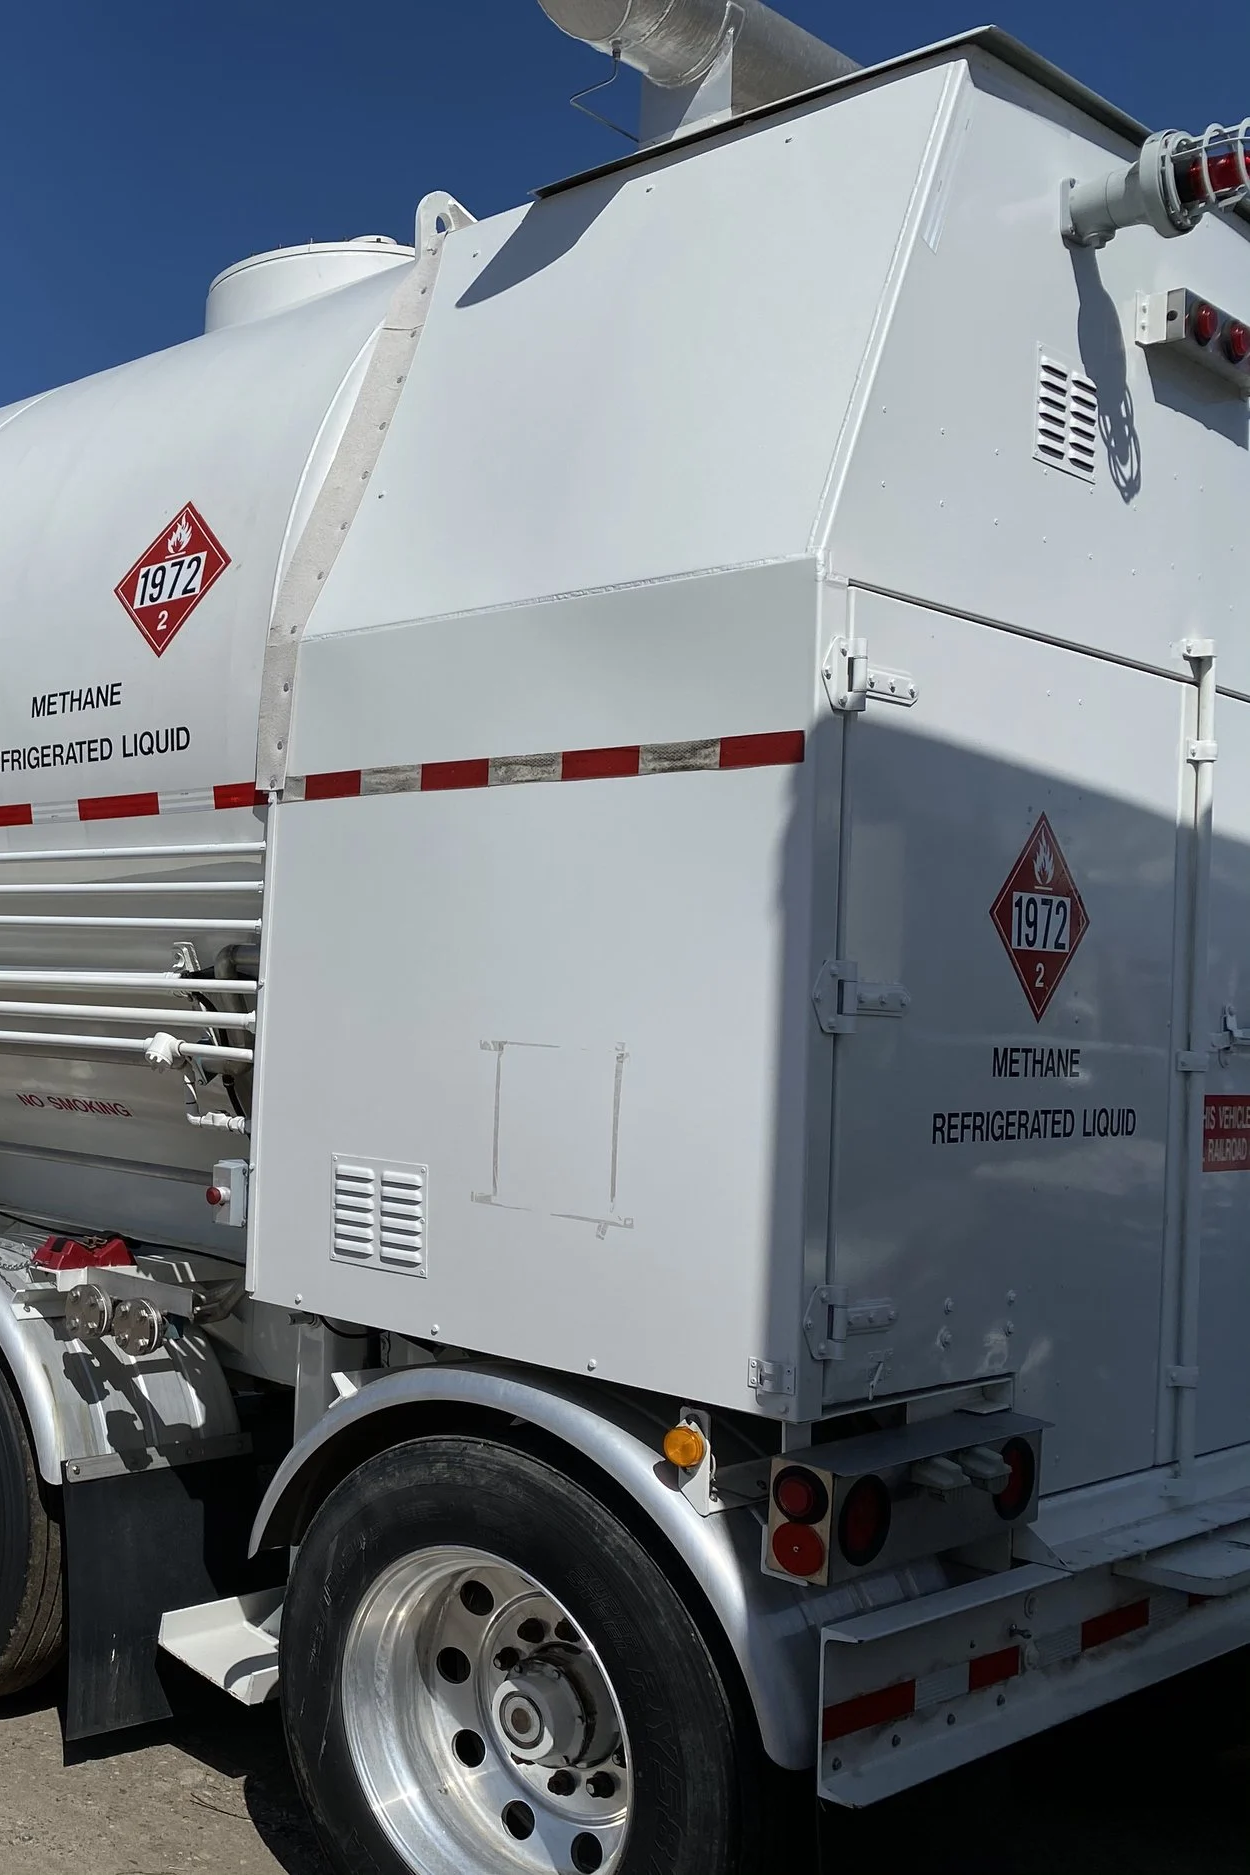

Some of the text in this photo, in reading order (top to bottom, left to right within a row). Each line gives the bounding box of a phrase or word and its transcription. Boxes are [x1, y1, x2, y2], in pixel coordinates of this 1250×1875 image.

[139, 555, 202, 606] 1972
[156, 610, 169, 631] 2
[31, 682, 122, 718] METHANE
[122, 726, 191, 758] LIQUID
[1014, 895, 1068, 950] 1972
[1035, 962, 1045, 988] 2
[992, 1047, 1081, 1078] METHANE
[15, 1093, 133, 1118] NO SMOKING
[932, 1107, 1137, 1145] REFRIGERATED LIQUID
[1208, 1137, 1248, 1162] RAILROAD
